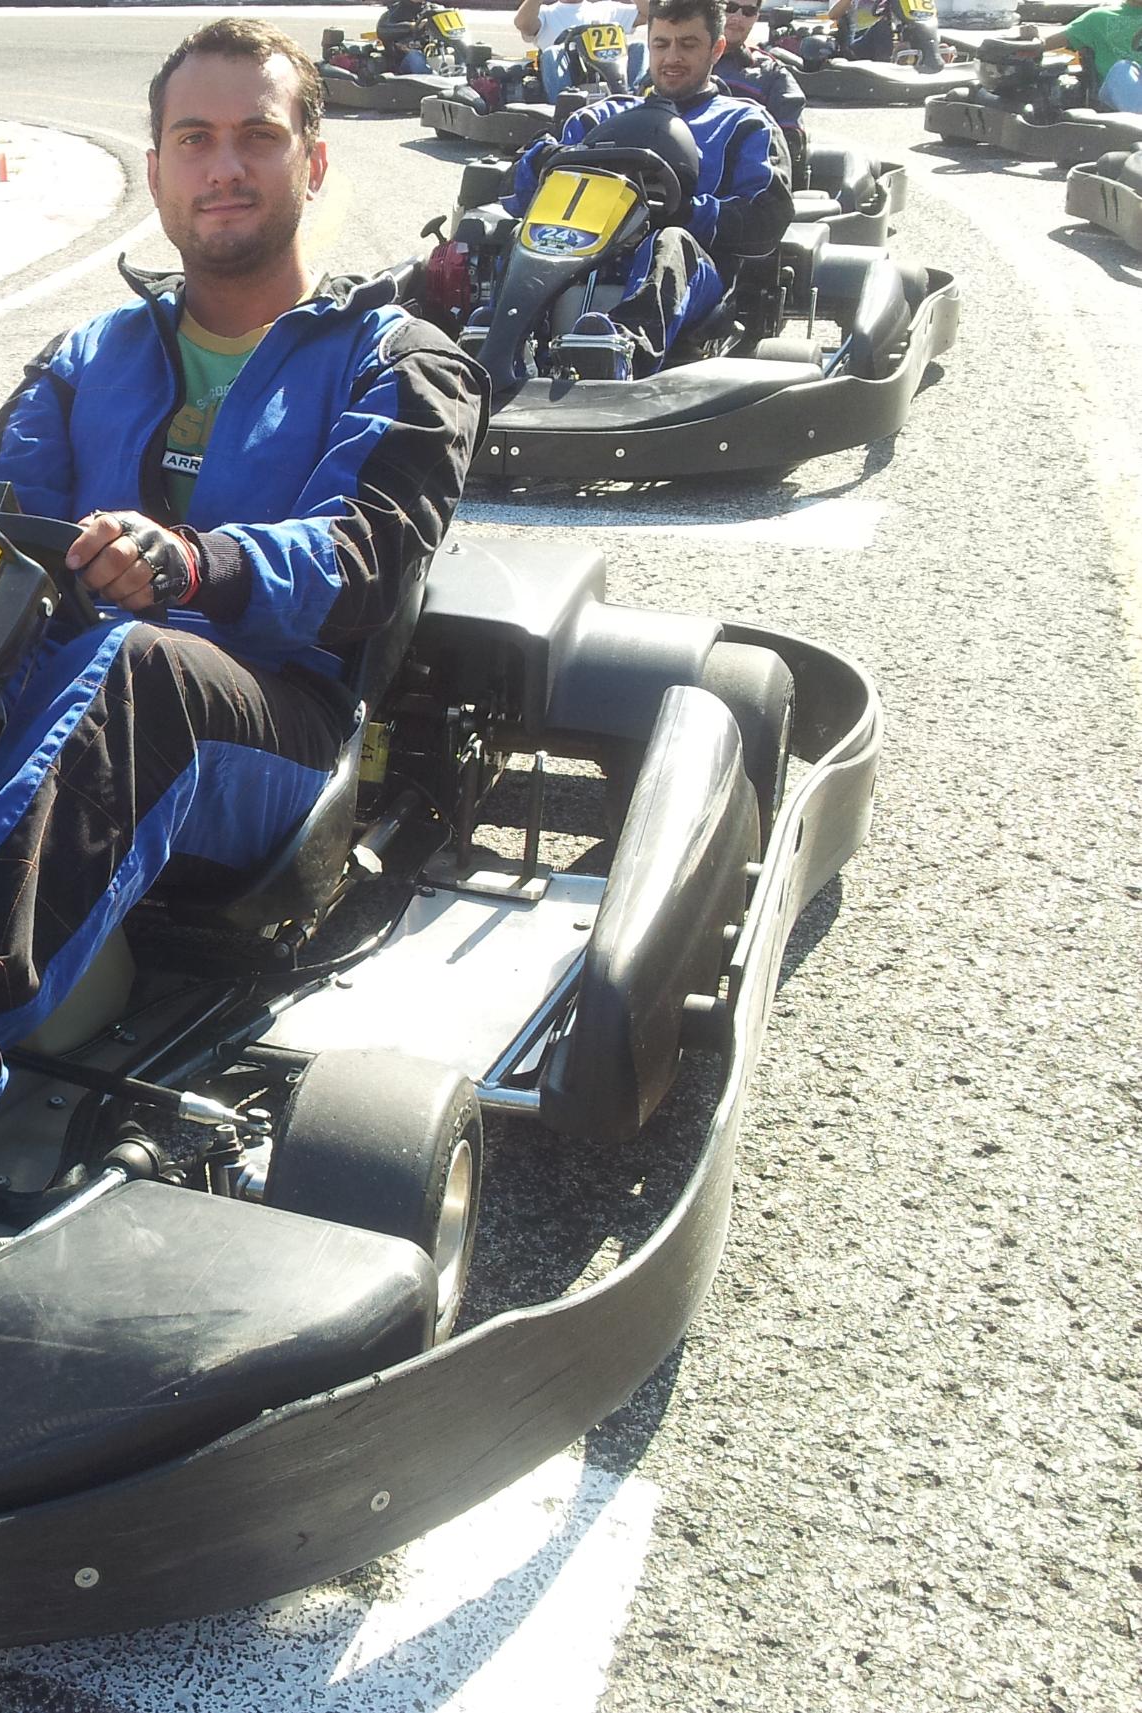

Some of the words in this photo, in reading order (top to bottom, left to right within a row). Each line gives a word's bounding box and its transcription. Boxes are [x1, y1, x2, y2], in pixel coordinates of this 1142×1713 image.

[592, 27, 620, 47] 22
[561, 177, 590, 221] 1
[542, 228, 570, 241] 24
